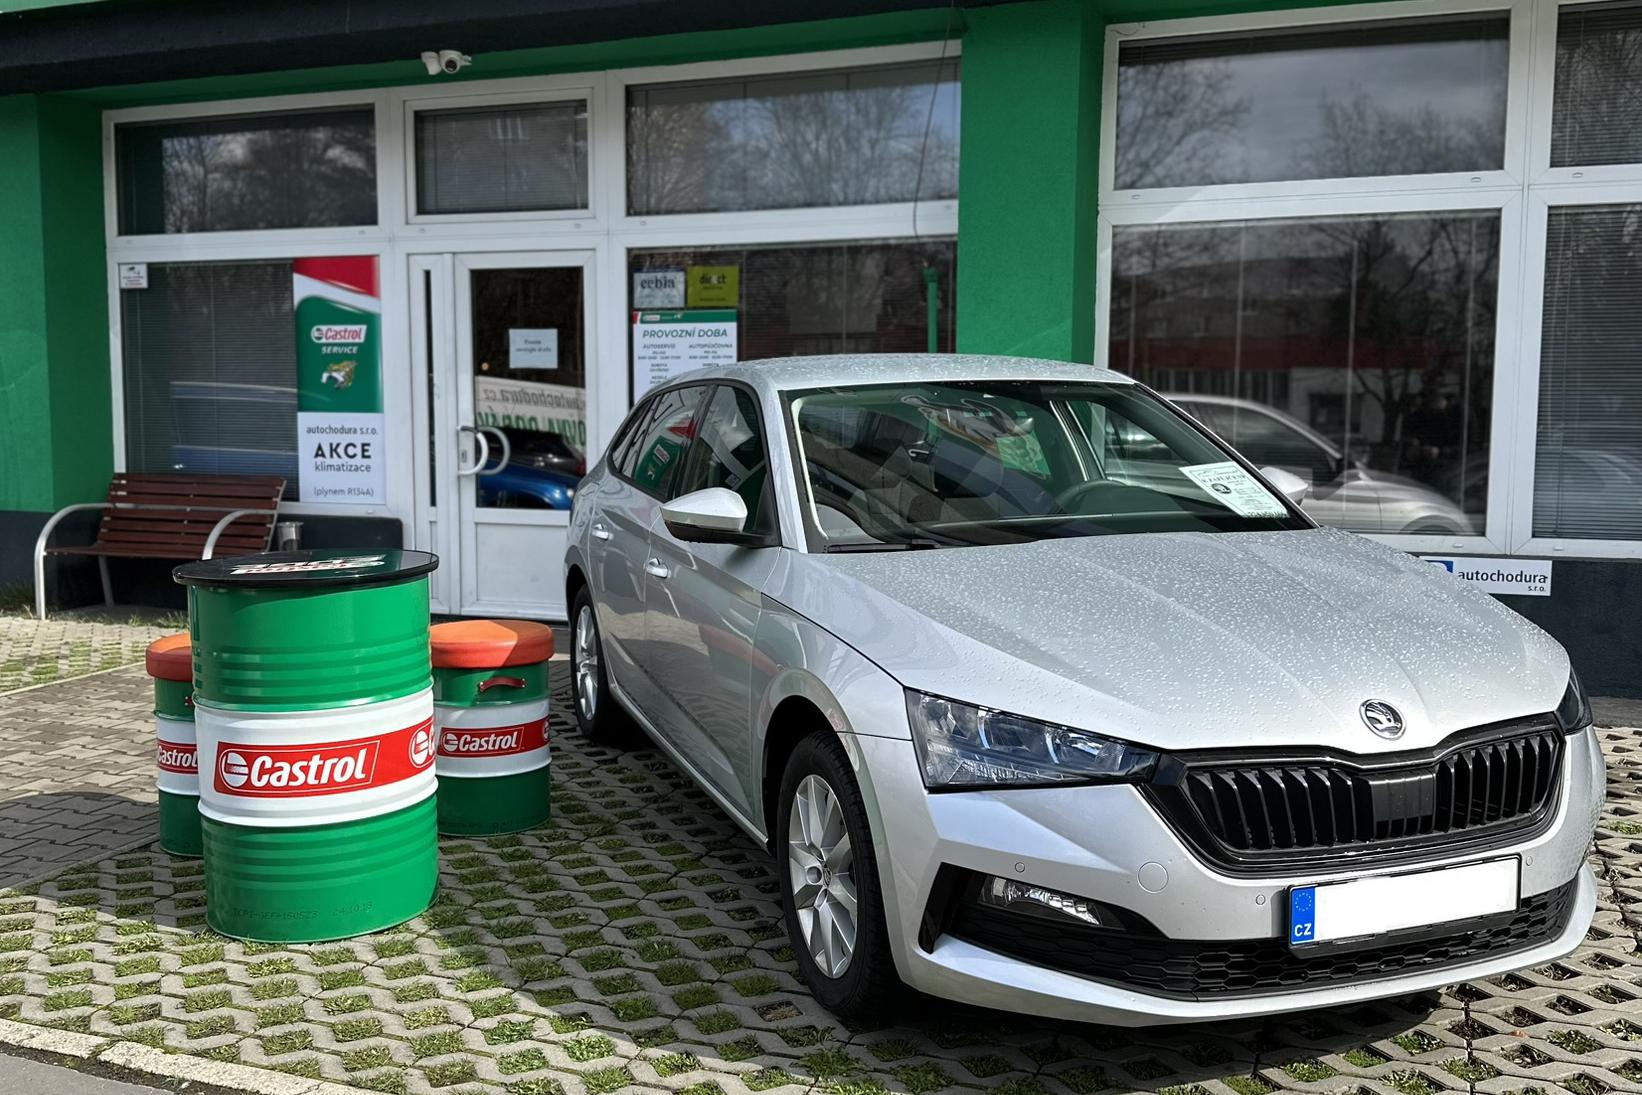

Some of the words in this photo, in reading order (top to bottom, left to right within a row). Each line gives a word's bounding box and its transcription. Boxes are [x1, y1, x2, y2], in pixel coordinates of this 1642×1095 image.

[324, 327, 362, 340] Castrol
[642, 327, 696, 338] PROVOZNÍ
[698, 328, 728, 338] DOBA
[321, 346, 358, 354] SERVICE
[306, 424, 358, 435] autochodura
[360, 427, 379, 435] s.r.o.
[314, 442, 372, 459] AKCE
[314, 461, 372, 473] klimatizace
[1458, 569, 1548, 584] autochodura
[459, 731, 518, 752] Castrol
[158, 745, 198, 768] astrol
[250, 748, 368, 788] Castrol
[1294, 922, 1312, 937] CZ
